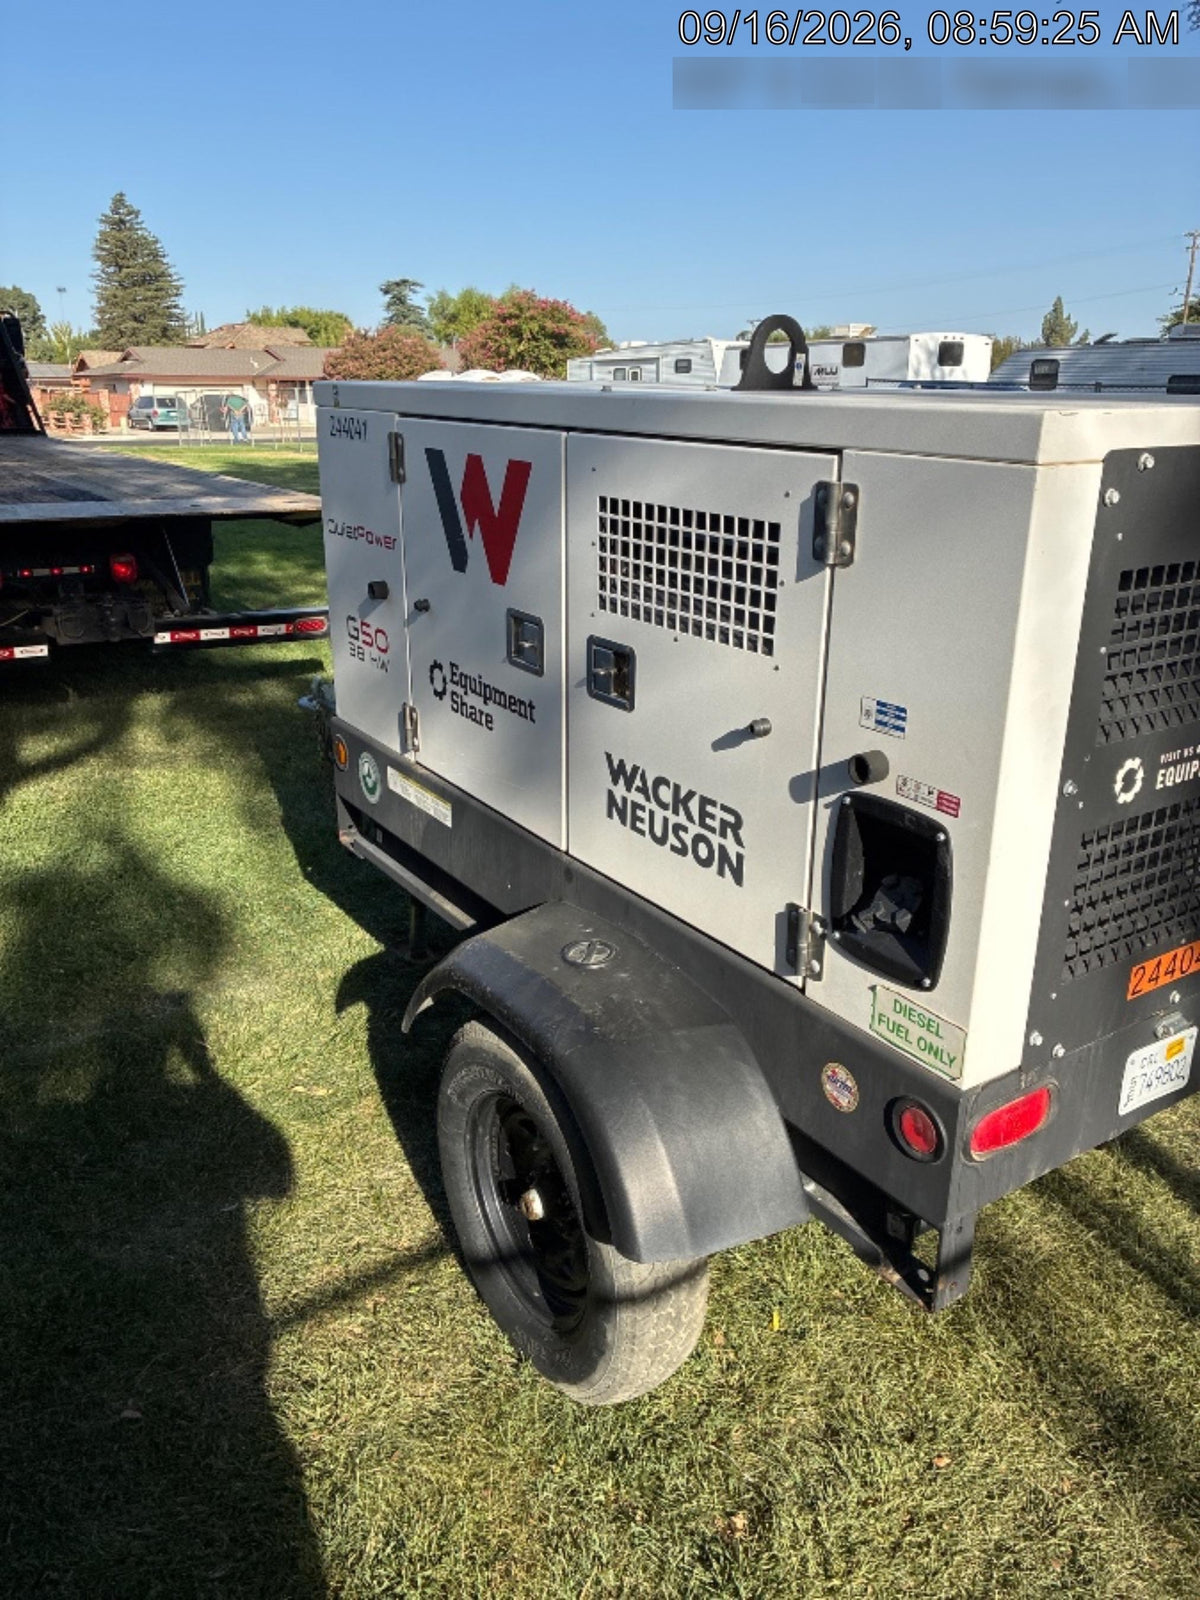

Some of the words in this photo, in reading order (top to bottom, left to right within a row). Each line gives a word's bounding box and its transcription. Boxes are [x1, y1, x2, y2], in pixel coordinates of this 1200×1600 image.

[346, 615, 390, 654] G50
[449, 661, 536, 724] Equipment
[449, 691, 494, 731] Share
[1155, 759, 1200, 790] EQUIP
[604, 751, 746, 850] WACKER
[606, 788, 745, 888] NEUSON
[1132, 946, 1200, 996] 2440
[877, 1012, 913, 1045] FUEL
[917, 1036, 957, 1070] ONLY
[892, 998, 944, 1040] DIESEL
